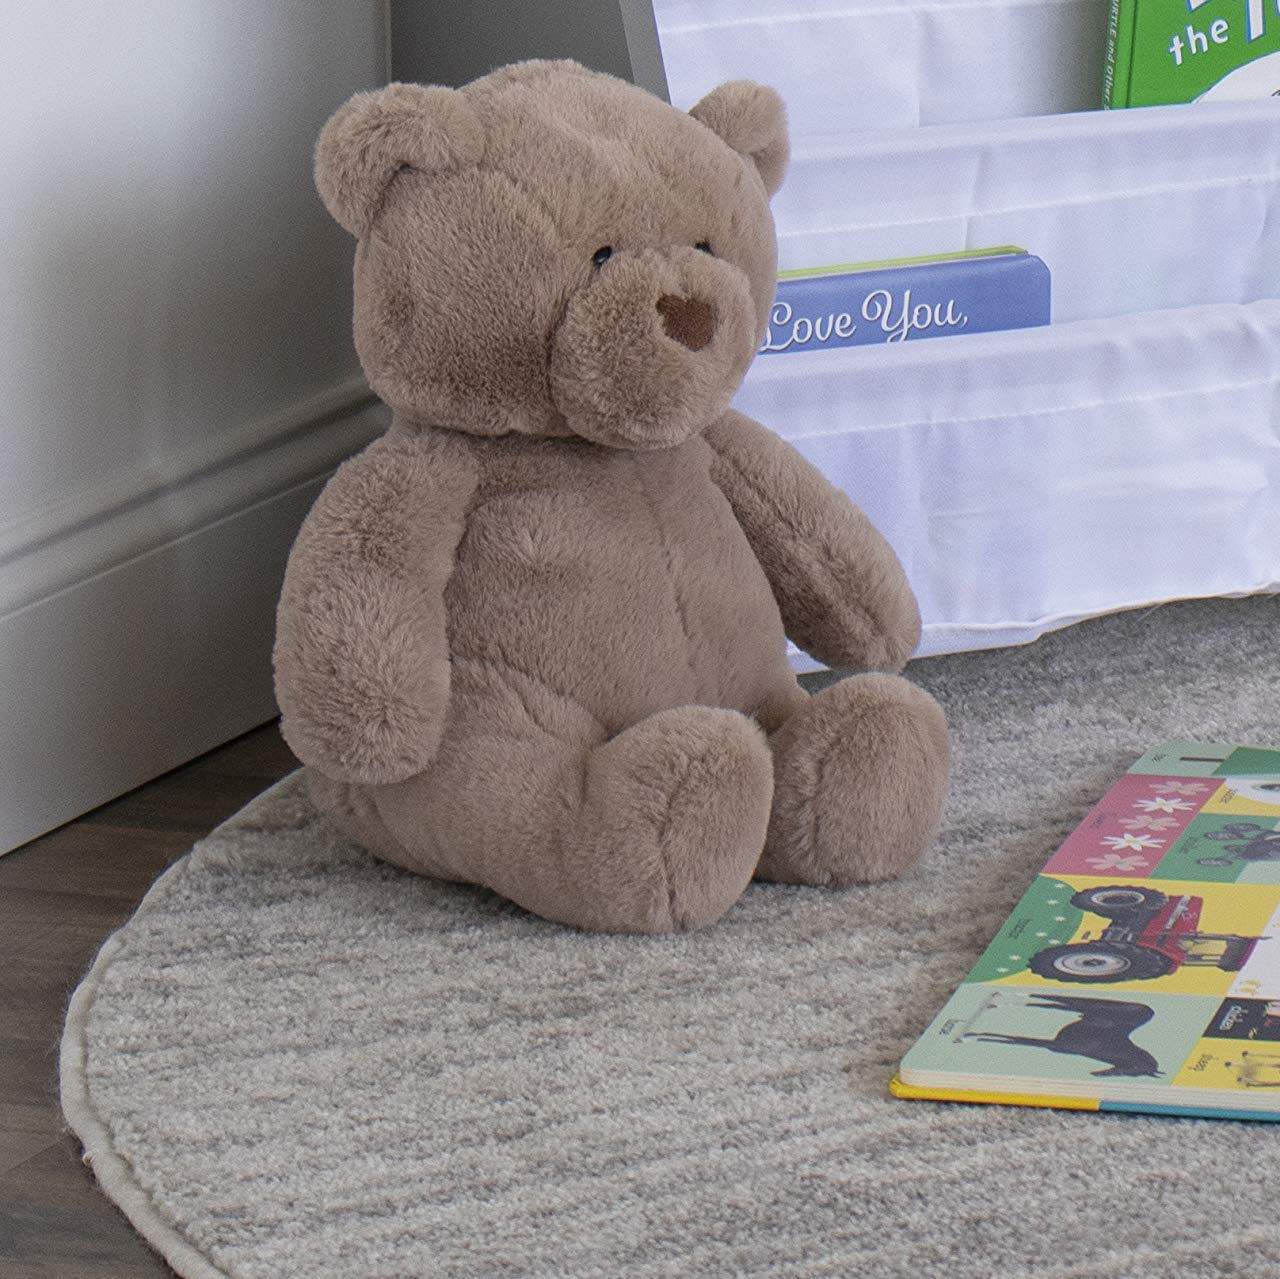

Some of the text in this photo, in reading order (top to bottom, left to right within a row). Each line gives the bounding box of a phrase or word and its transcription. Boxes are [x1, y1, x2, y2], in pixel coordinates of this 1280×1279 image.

[1106, 39, 1116, 63] and
[1168, 19, 1230, 66] the
[1103, 64, 1114, 102] Other
[758, 289, 970, 352] Love You,
